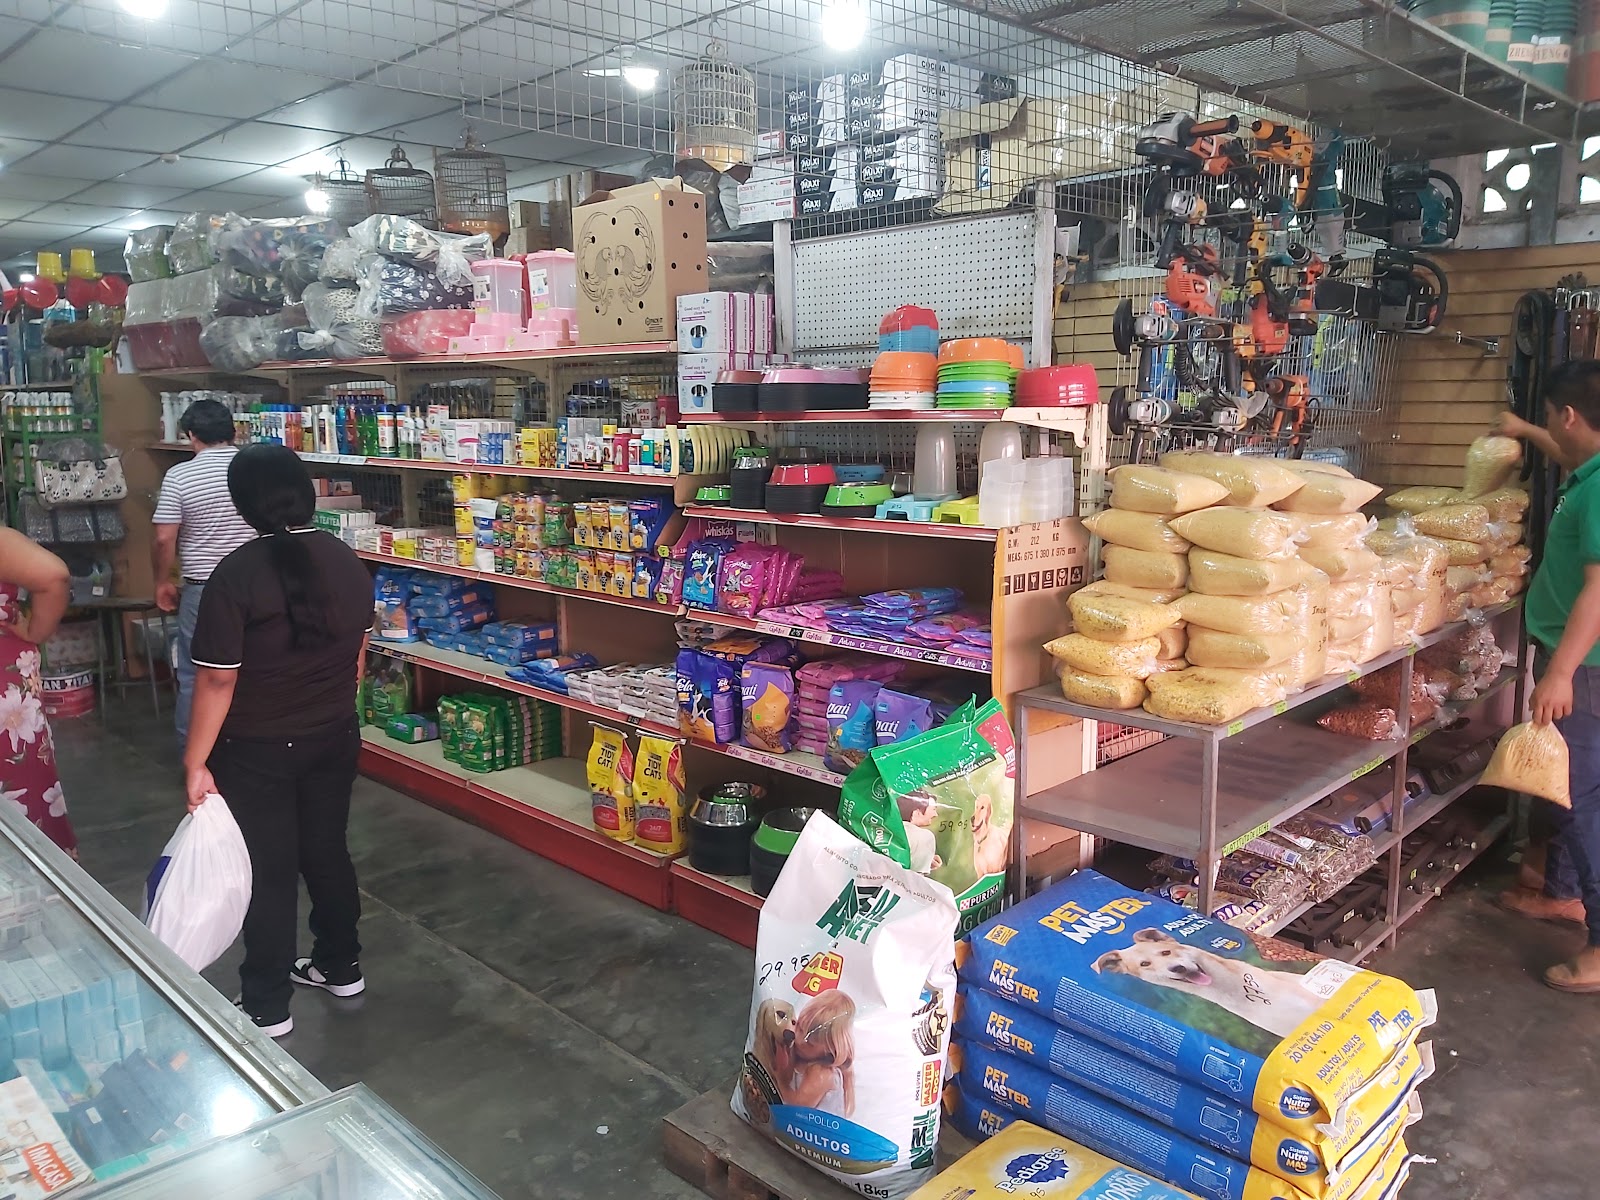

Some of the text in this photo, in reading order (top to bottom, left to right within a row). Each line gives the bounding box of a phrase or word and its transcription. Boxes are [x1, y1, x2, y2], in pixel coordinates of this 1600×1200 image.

[790, 135, 808, 146] MAXI
[800, 178, 820, 190] MAXI
[863, 188, 884, 200] MAXI
[802, 198, 821, 210] MAXI
[705, 525, 734, 540] whiskas
[1052, 532, 1060, 542] KG
[1007, 552, 1023, 563] MEAS:
[65, 674, 92, 687] TITA
[597, 757, 613, 769] CATS
[600, 747, 615, 760] TIDY
[643, 768, 662, 780] CATS
[647, 758, 662, 770] TIDY
[970, 884, 999, 907] PURINA
[1038, 900, 1090, 933] PET
[1062, 897, 1152, 945] MASTER
[992, 959, 1018, 979] PET
[989, 970, 1040, 1003] MASTER
[989, 1010, 1014, 1031] PET
[1367, 1010, 1388, 1033] PET
[986, 1022, 1035, 1055] MASTER
[1289, 1049, 1304, 1065] 20
[1298, 1040, 1313, 1056] kg
[1316, 1054, 1342, 1080] ADULTOS
[1340, 1033, 1362, 1055] ADULTS
[923, 1064, 933, 1105] MASTER
[932, 1070, 940, 1093] DOG
[985, 1065, 1009, 1085] PET
[983, 1076, 1032, 1109] MASTER
[1283, 1096, 1311, 1108] Nutre
[808, 1113, 840, 1131] POLLO
[980, 1109, 1005, 1129] PET
[786, 1123, 851, 1156] ADULTOS
[794, 1143, 843, 1169] PREMIUM
[1280, 1148, 1309, 1162] Nutre
[28, 1145, 68, 1190] IMACASA
[995, 1146, 1068, 1193] Pedigree
